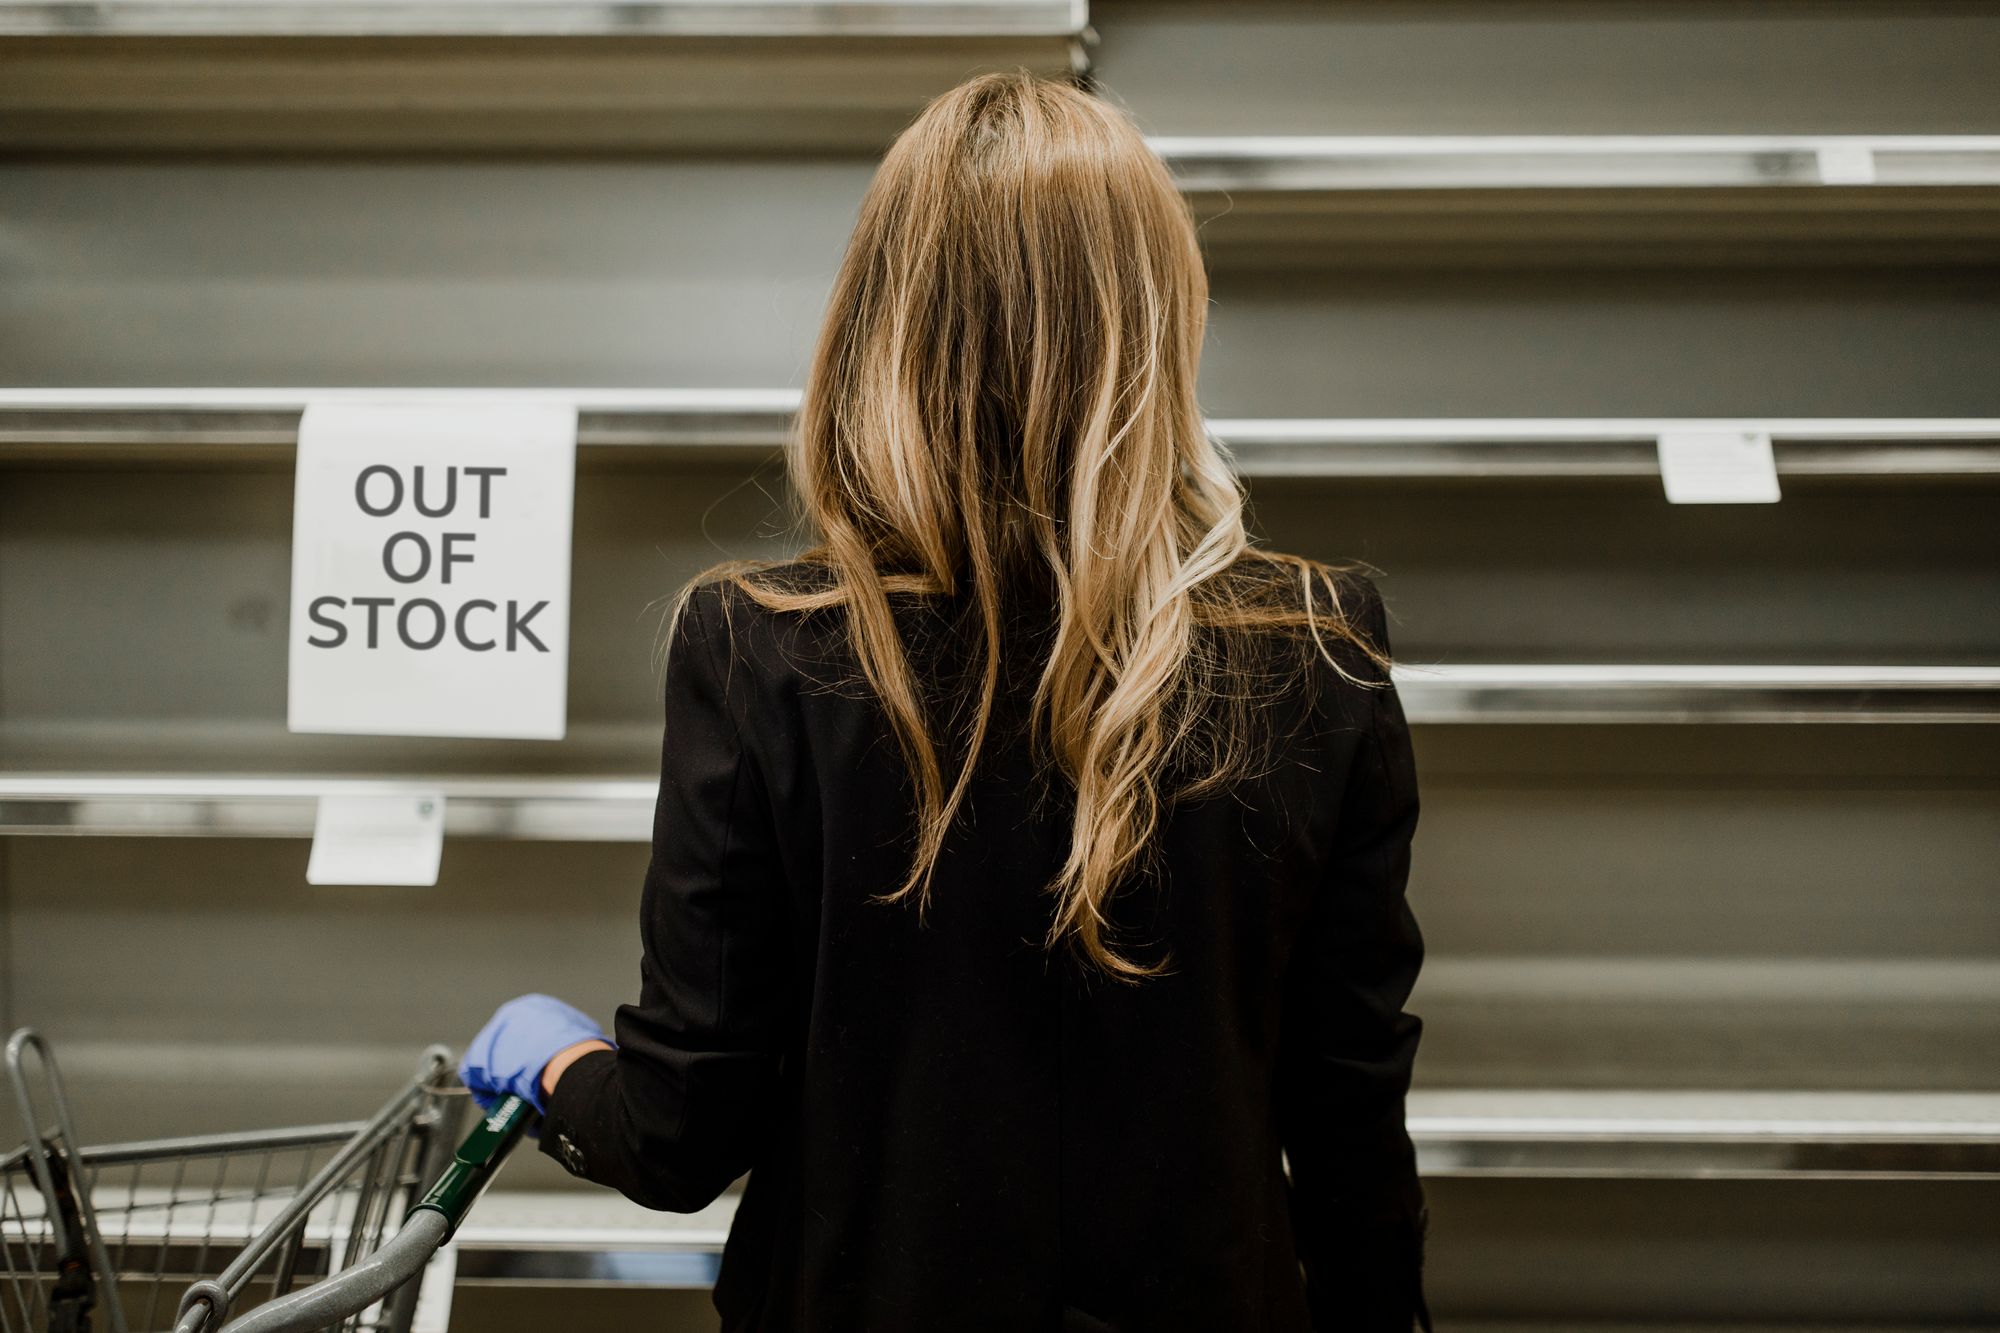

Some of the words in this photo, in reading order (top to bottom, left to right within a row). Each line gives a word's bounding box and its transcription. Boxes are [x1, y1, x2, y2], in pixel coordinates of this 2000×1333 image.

[355, 464, 507, 519] OUT
[382, 531, 476, 584] OF
[307, 596, 550, 653] STOCK
